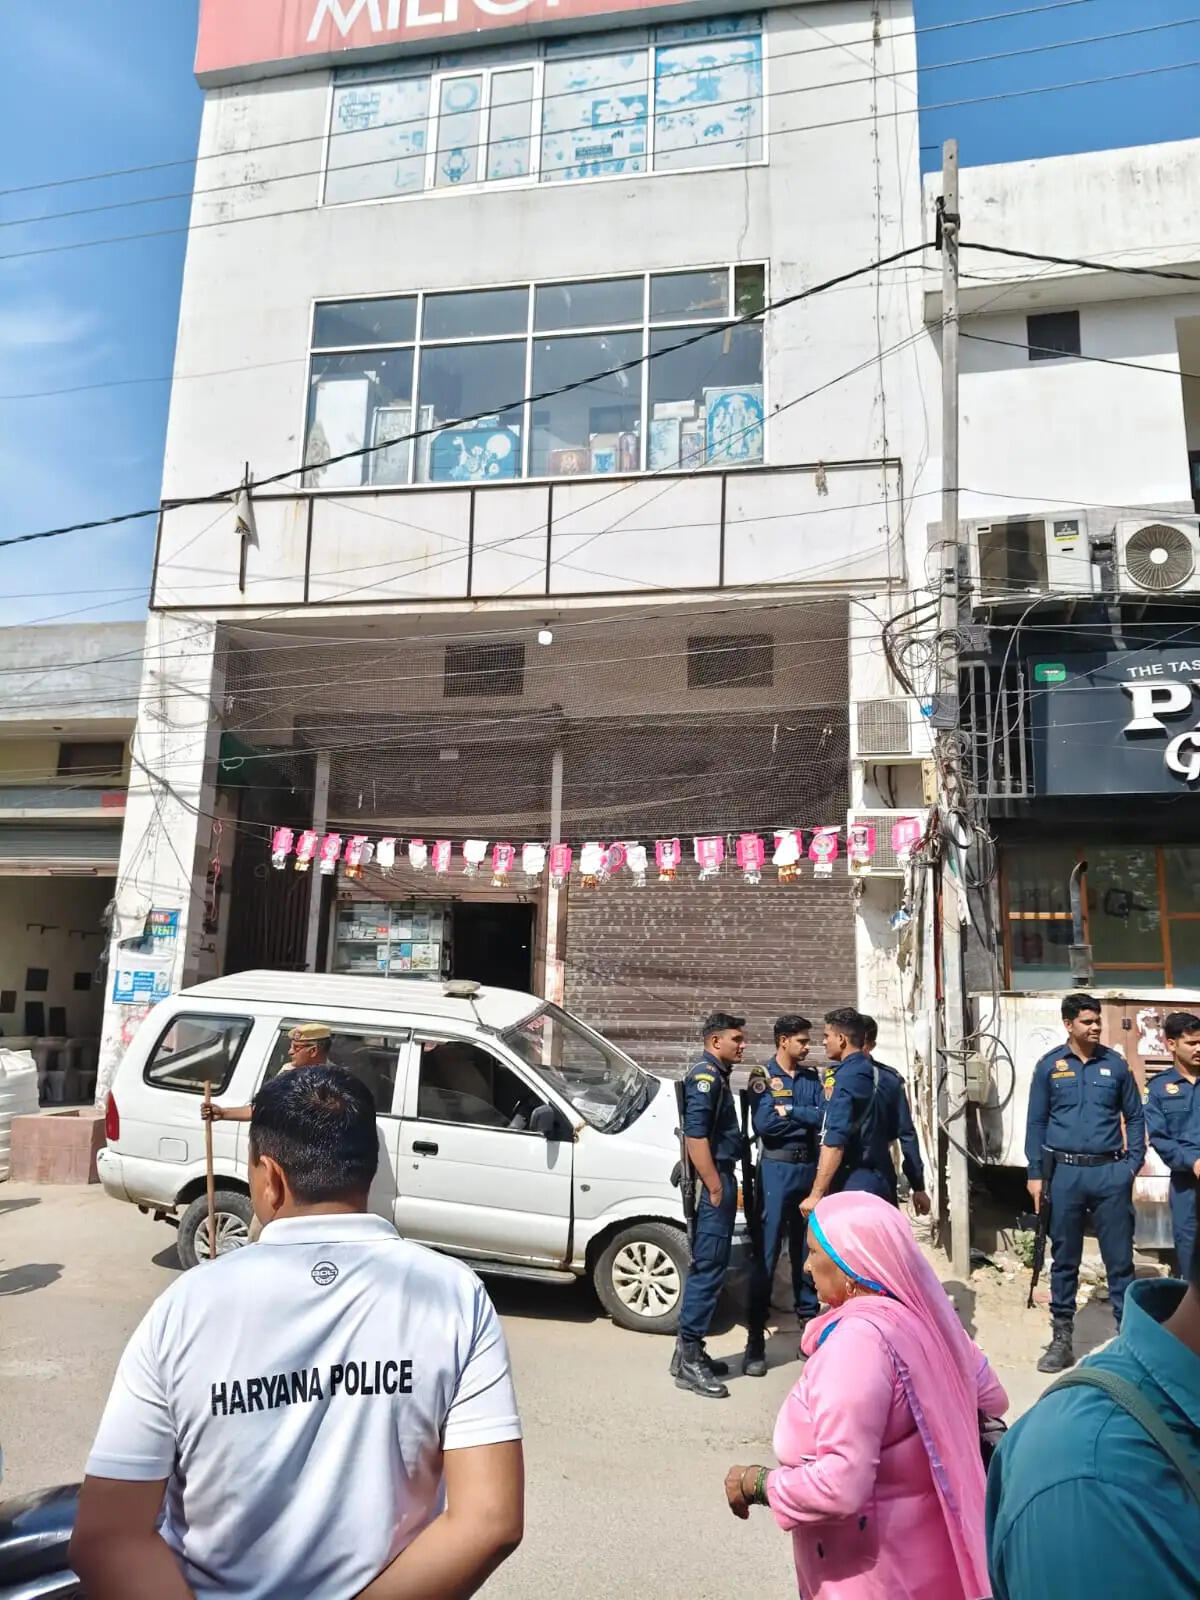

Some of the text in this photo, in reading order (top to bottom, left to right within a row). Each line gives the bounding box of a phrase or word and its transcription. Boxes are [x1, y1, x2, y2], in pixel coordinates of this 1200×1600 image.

[1126, 663, 1164, 678] THE
[1119, 680, 1200, 731] P
[211, 1360, 412, 1416] HARYANA POLICE
